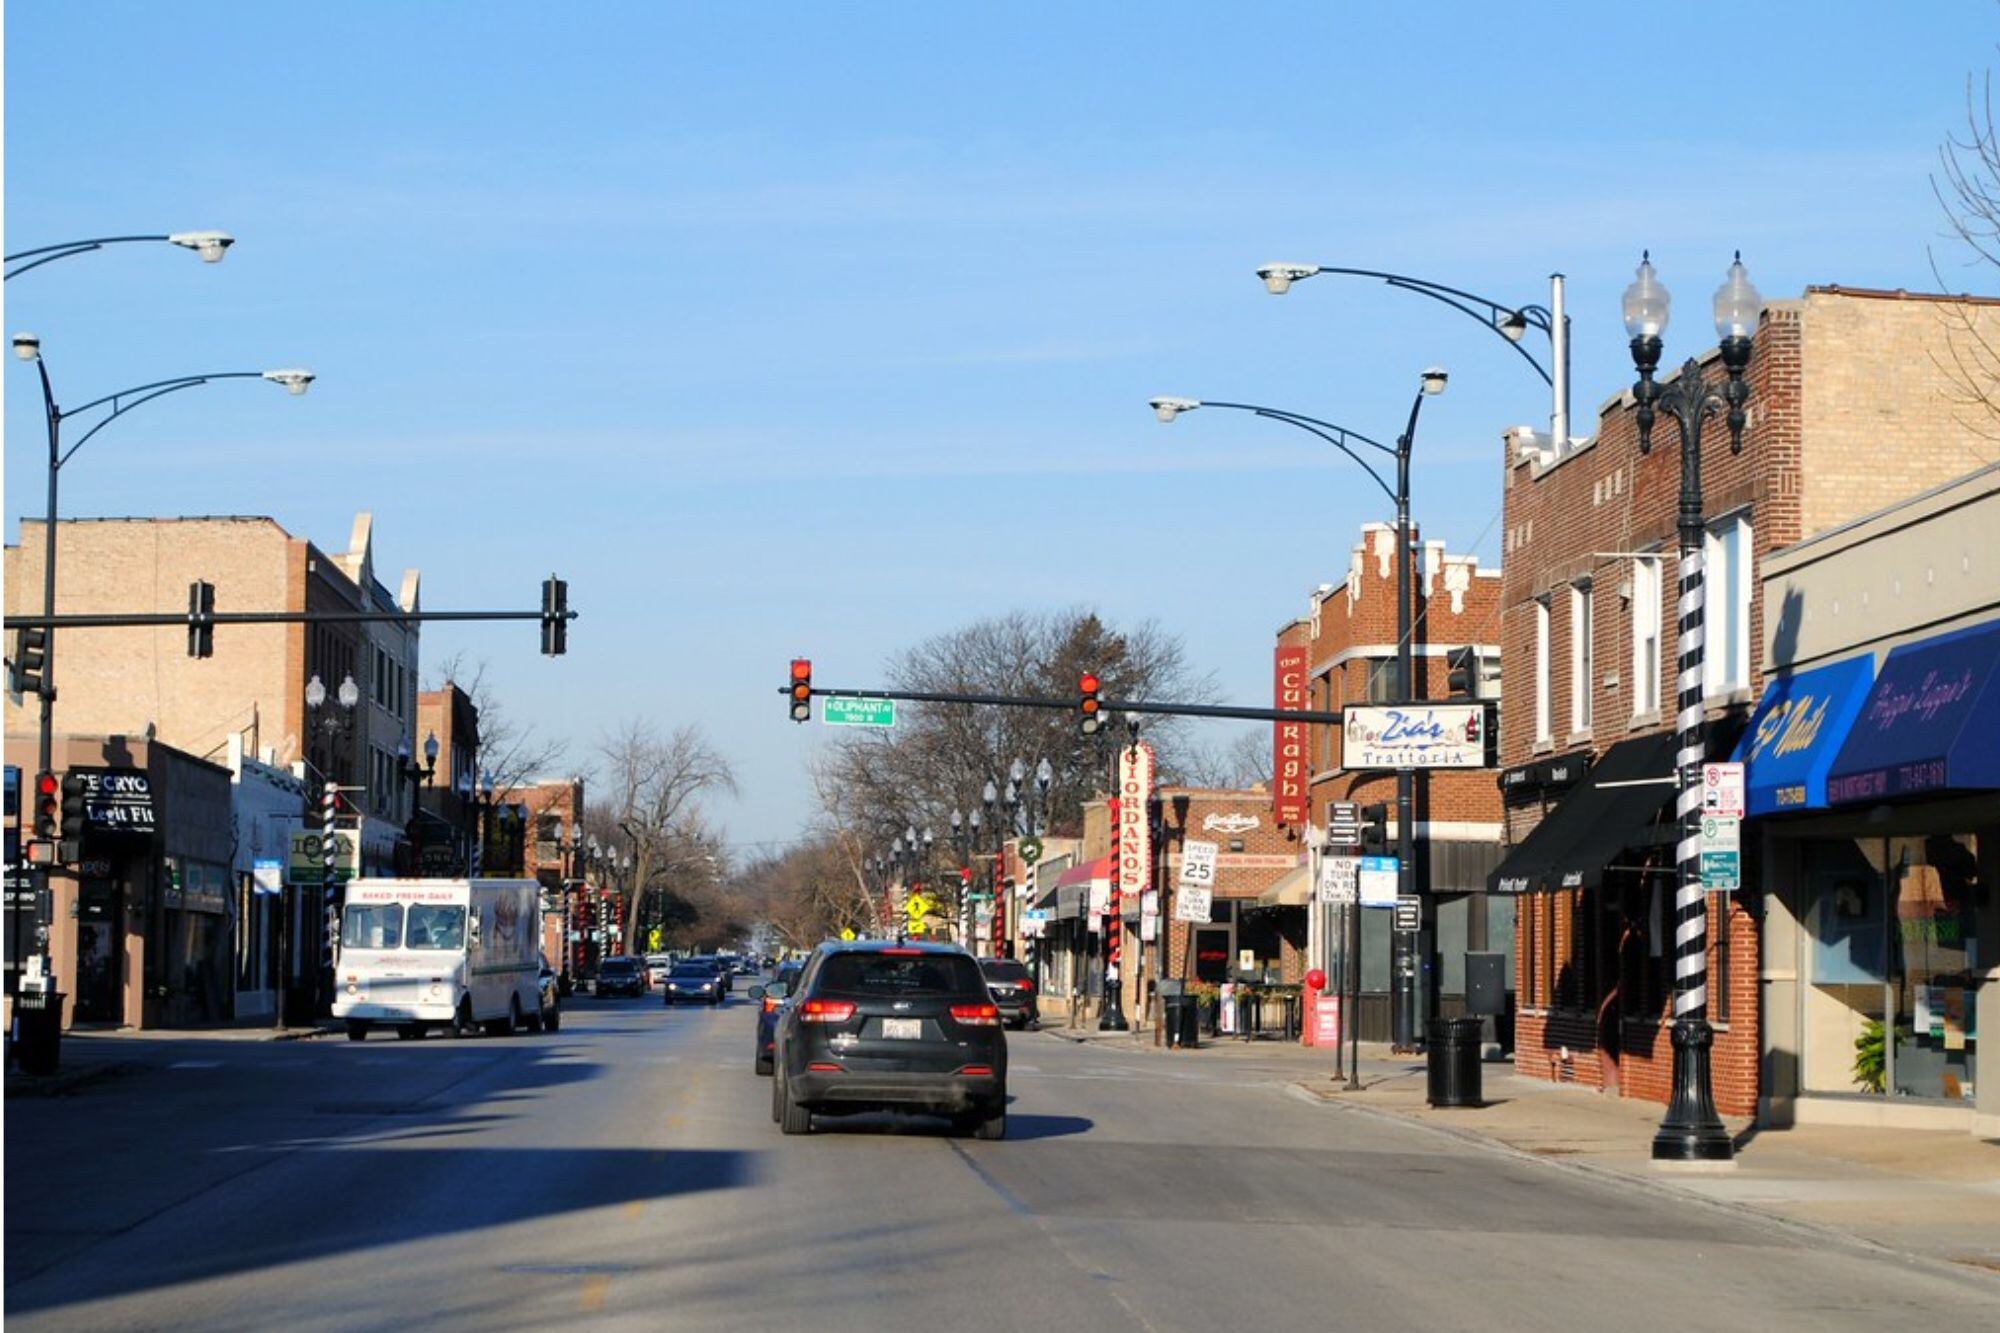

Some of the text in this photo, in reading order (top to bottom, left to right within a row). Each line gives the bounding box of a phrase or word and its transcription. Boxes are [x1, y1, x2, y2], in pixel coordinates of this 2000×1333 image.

[833, 701, 882, 714] OLIPHANT
[1381, 710, 1444, 742] Zia's
[103, 776, 148, 792] CRYO
[86, 805, 155, 826] Legit Fit
[1123, 751, 1143, 886] GIORDANO'S
[1188, 844, 1215, 854] SPEED
[1188, 853, 1211, 862] LIMIT
[1335, 861, 1352, 870] NO
[1184, 862, 1211, 880] 25
[1331, 870, 1356, 880] TURN
[1325, 881, 1356, 890] ON RE
[362, 891, 454, 900] BAKED FRESH DAILY
[1188, 889, 1201, 897] NO
[1184, 896, 1205, 904] TURN
